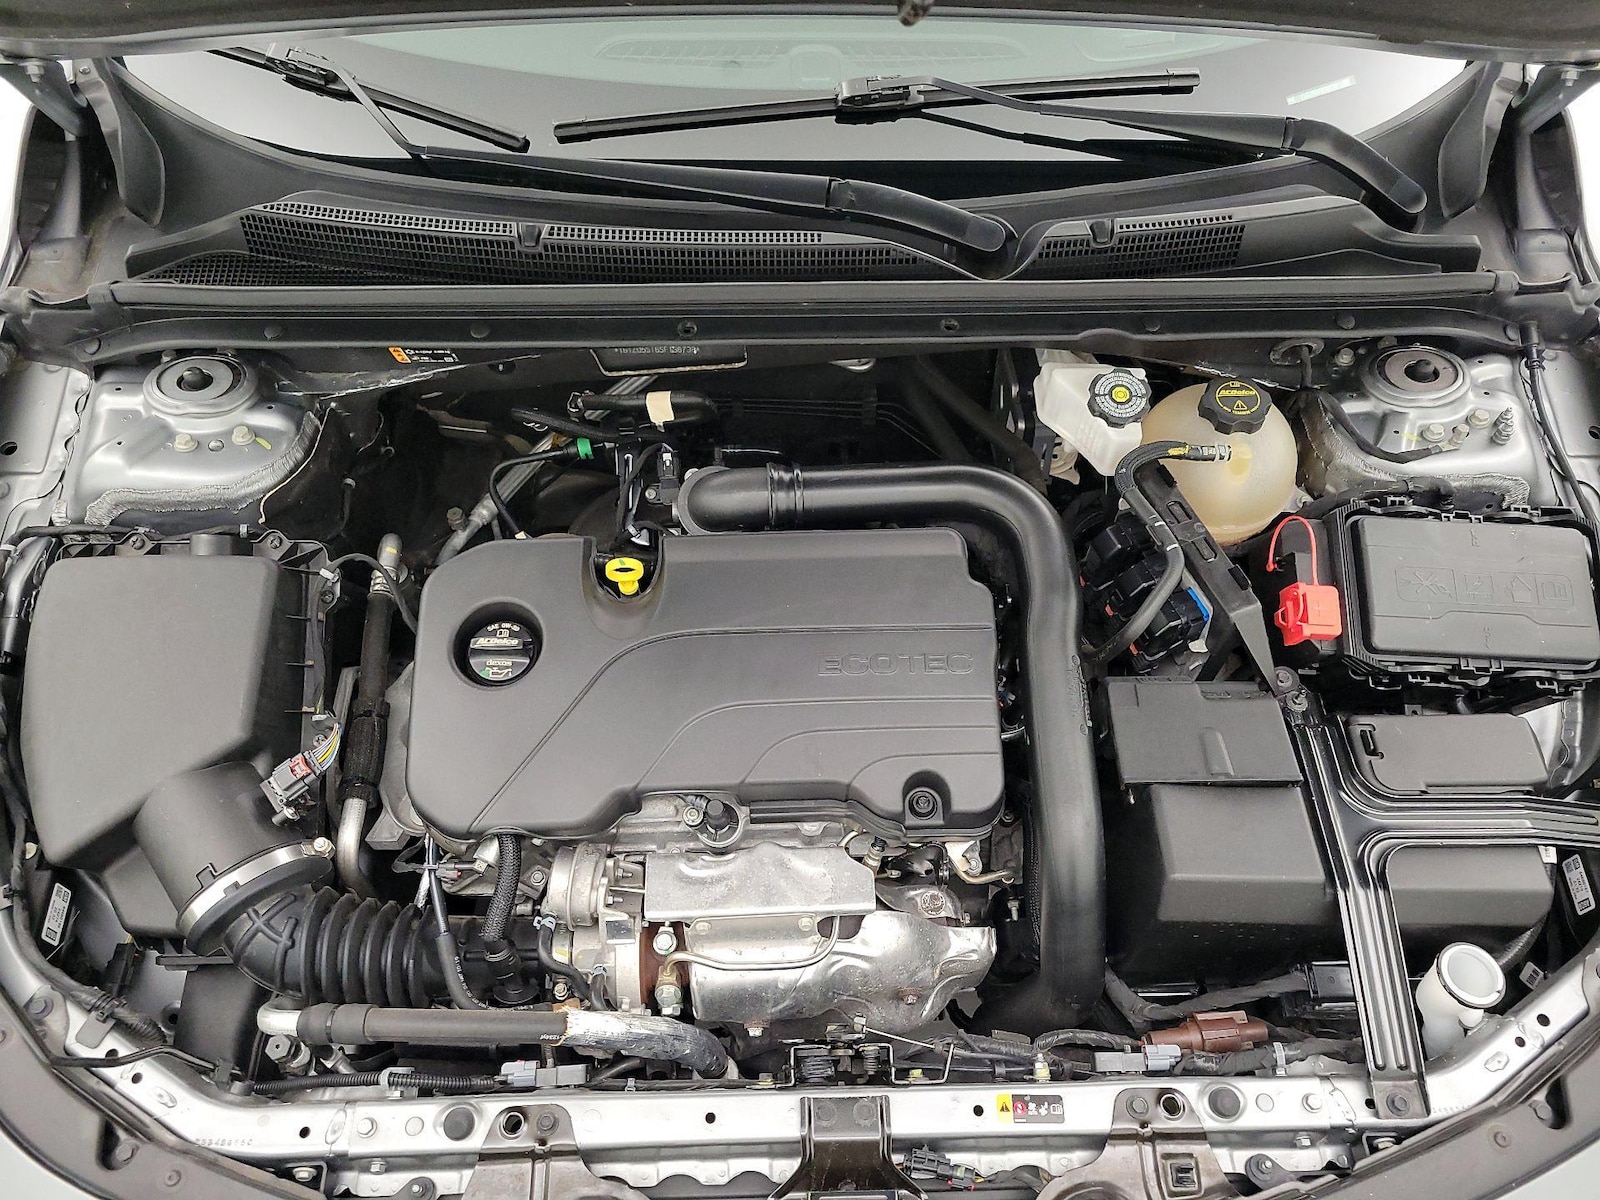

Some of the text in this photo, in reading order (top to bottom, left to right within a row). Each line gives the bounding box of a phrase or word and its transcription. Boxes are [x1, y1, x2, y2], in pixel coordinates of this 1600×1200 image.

[1219, 389, 1257, 397] ACDelco
[486, 623, 500, 632] SAE
[475, 637, 519, 645] ACDelco
[817, 652, 974, 676] ECOTEC
